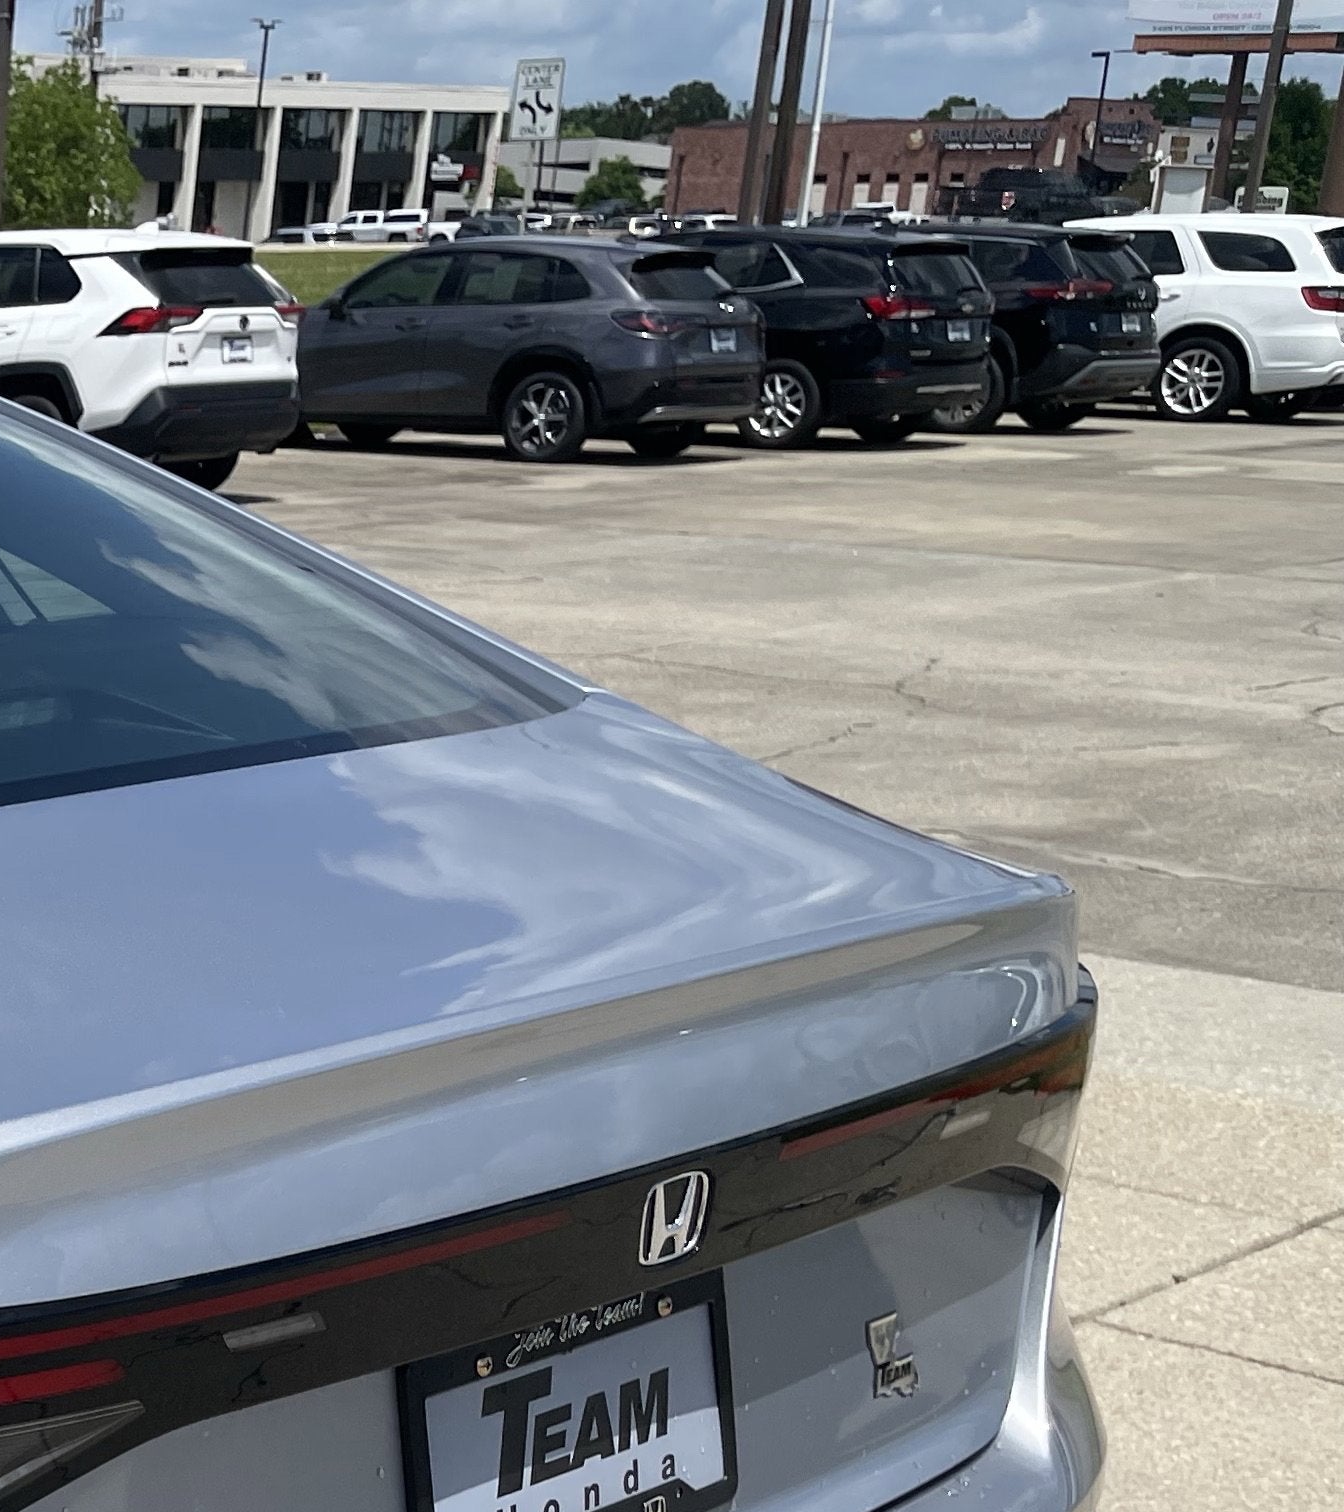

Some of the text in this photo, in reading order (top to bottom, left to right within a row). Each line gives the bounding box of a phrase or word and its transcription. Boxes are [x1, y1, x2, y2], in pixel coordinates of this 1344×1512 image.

[524, 76, 554, 88] LANE
[877, 1361, 913, 1387] TEAM
[480, 1366, 670, 1498] TEAM
